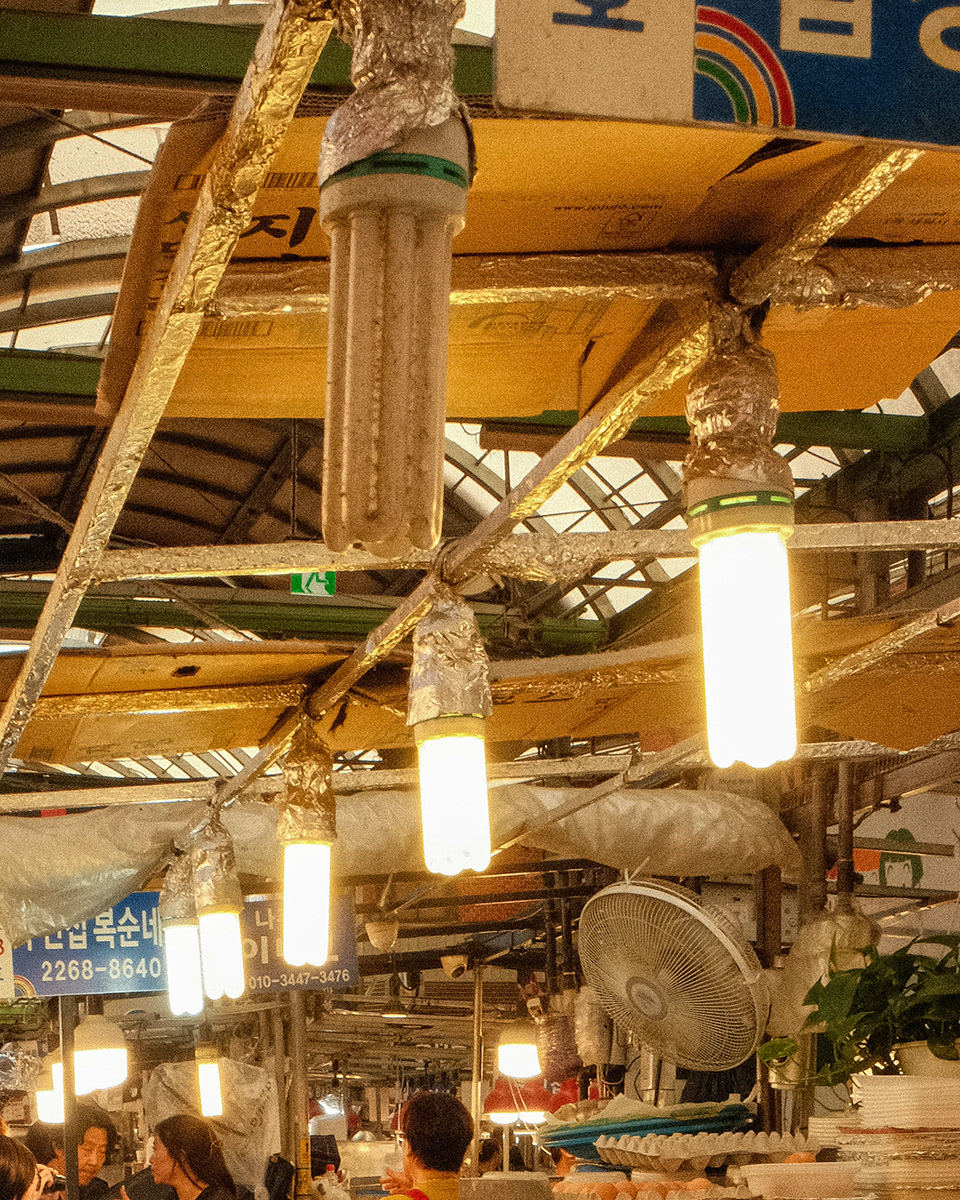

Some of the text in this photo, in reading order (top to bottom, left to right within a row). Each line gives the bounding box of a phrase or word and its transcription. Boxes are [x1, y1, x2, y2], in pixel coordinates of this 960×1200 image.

[93, 906, 163, 950] 복순네
[41, 956, 162, 982] 2268-8640
[248, 968, 351, 990] 010-3447-3476
